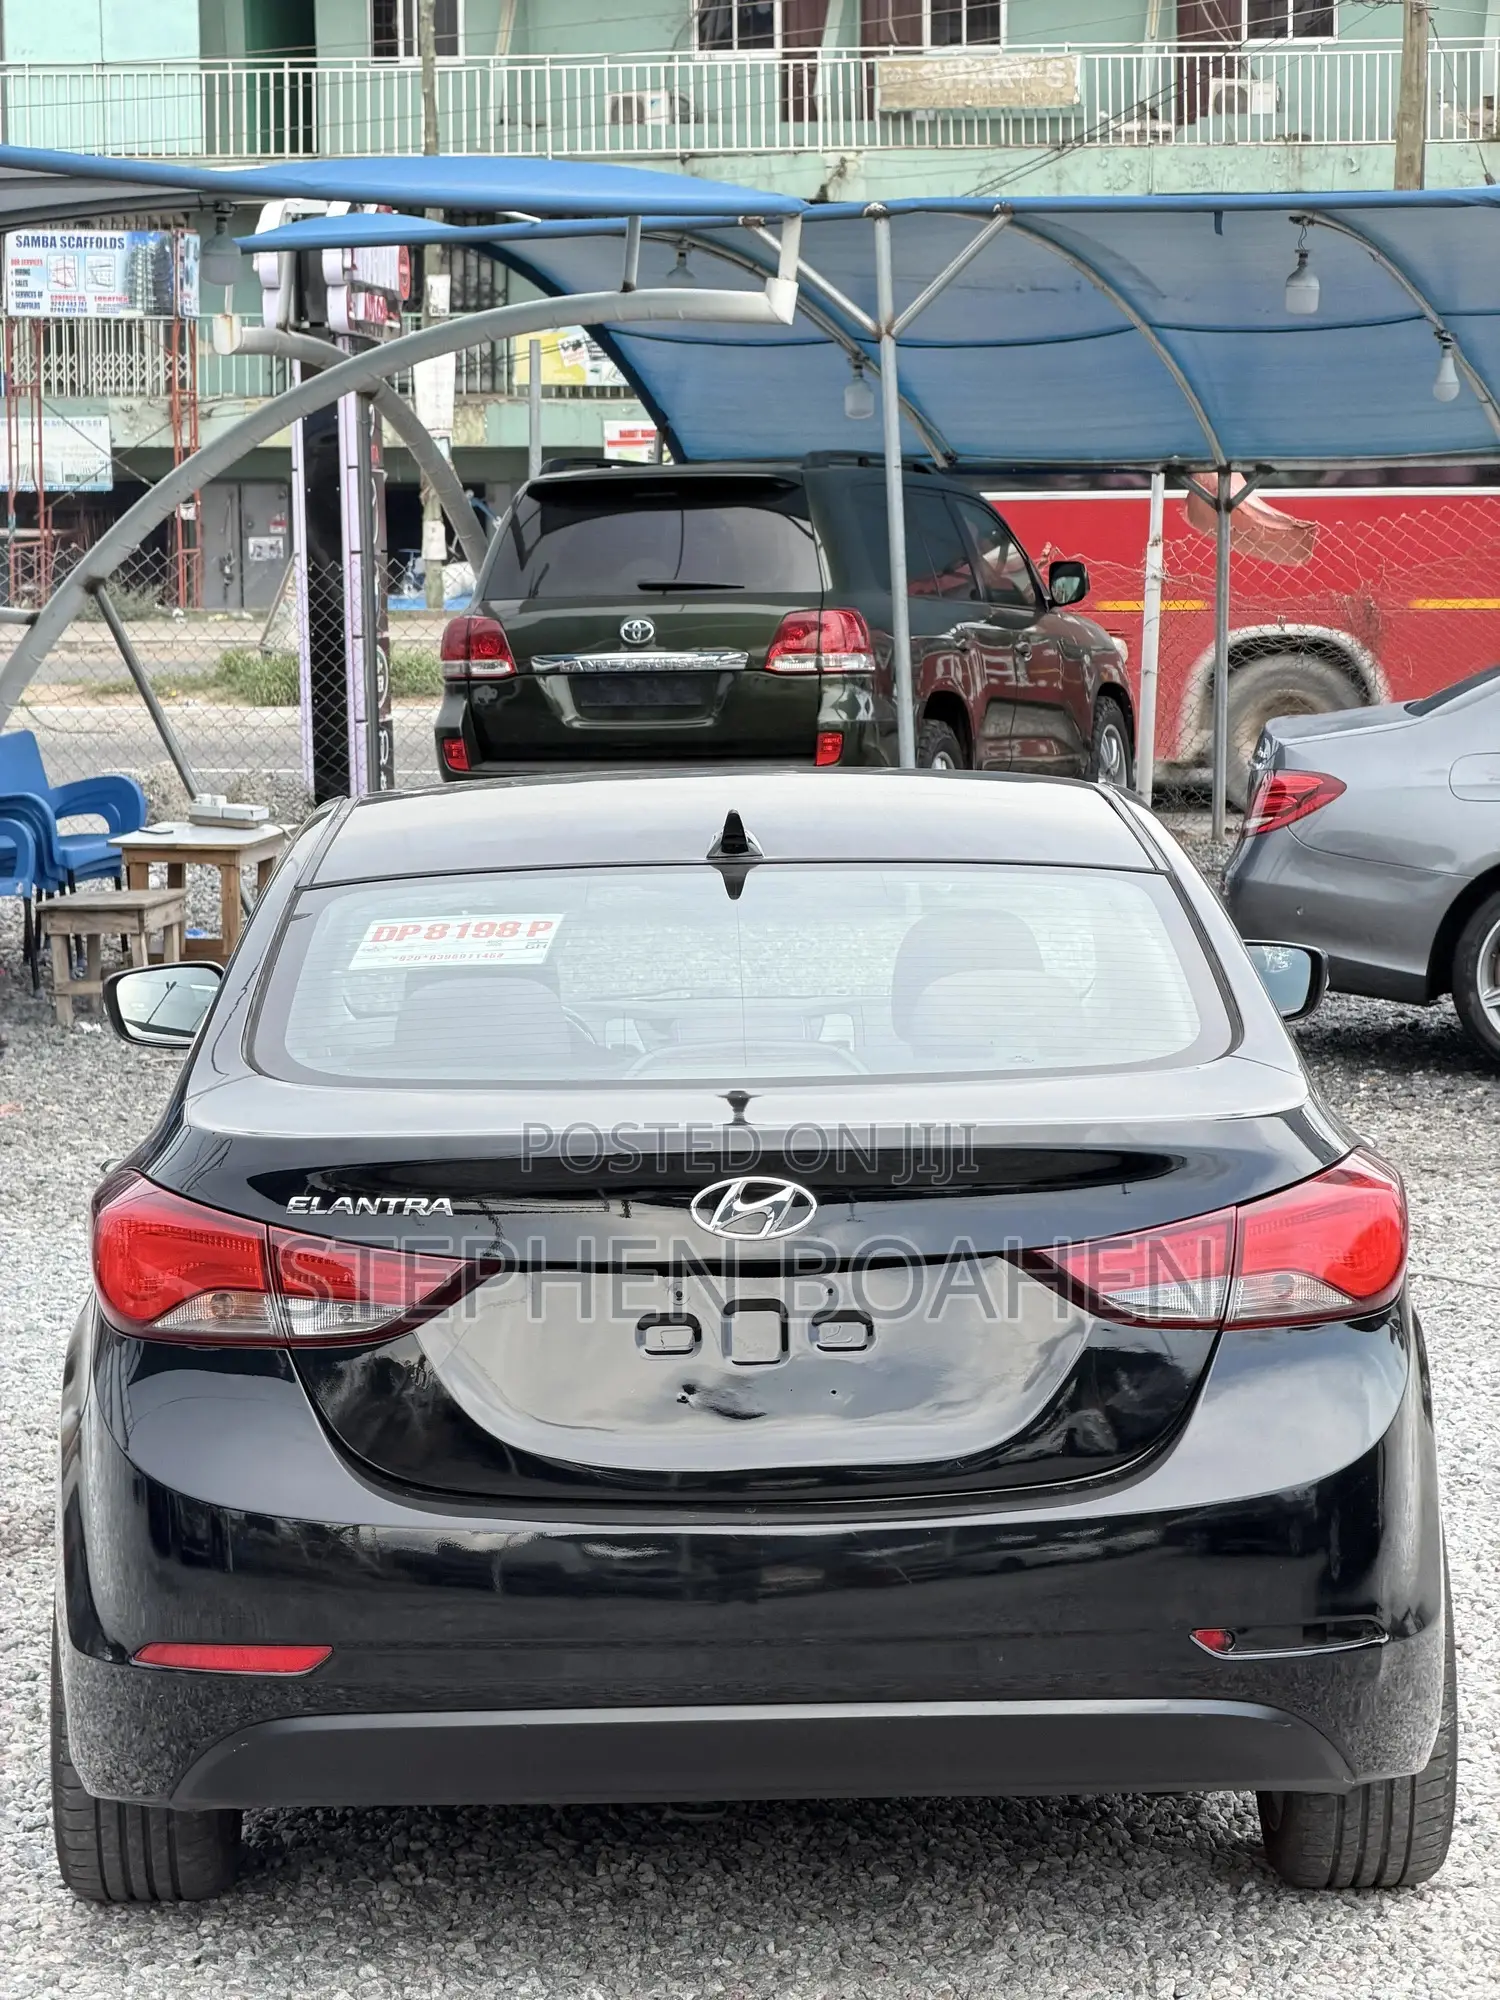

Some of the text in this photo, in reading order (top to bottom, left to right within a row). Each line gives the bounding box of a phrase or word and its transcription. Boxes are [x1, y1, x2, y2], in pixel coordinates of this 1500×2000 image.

[16, 235, 125, 249] SAMBA SCAFFOLDS
[370, 923, 422, 943] DP
[526, 920, 554, 938] P
[285, 1196, 454, 1217] ELANTRA
